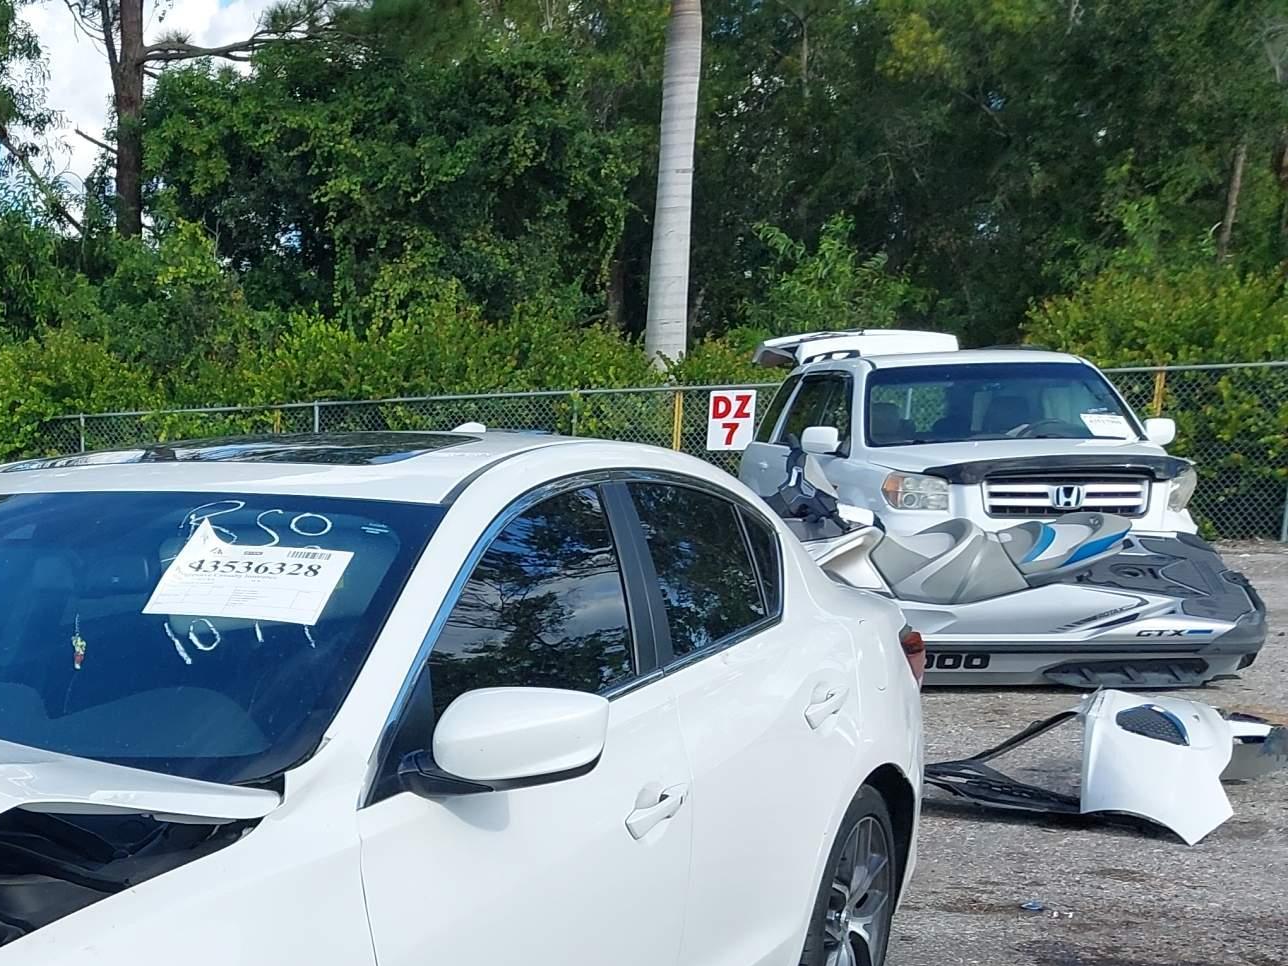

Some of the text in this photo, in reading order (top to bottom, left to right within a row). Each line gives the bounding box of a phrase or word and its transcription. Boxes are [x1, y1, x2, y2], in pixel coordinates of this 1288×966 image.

[712, 395, 752, 419] DZ
[722, 422, 740, 446] 7
[188, 559, 323, 578] 43536328
[1135, 629, 1186, 637] GTX
